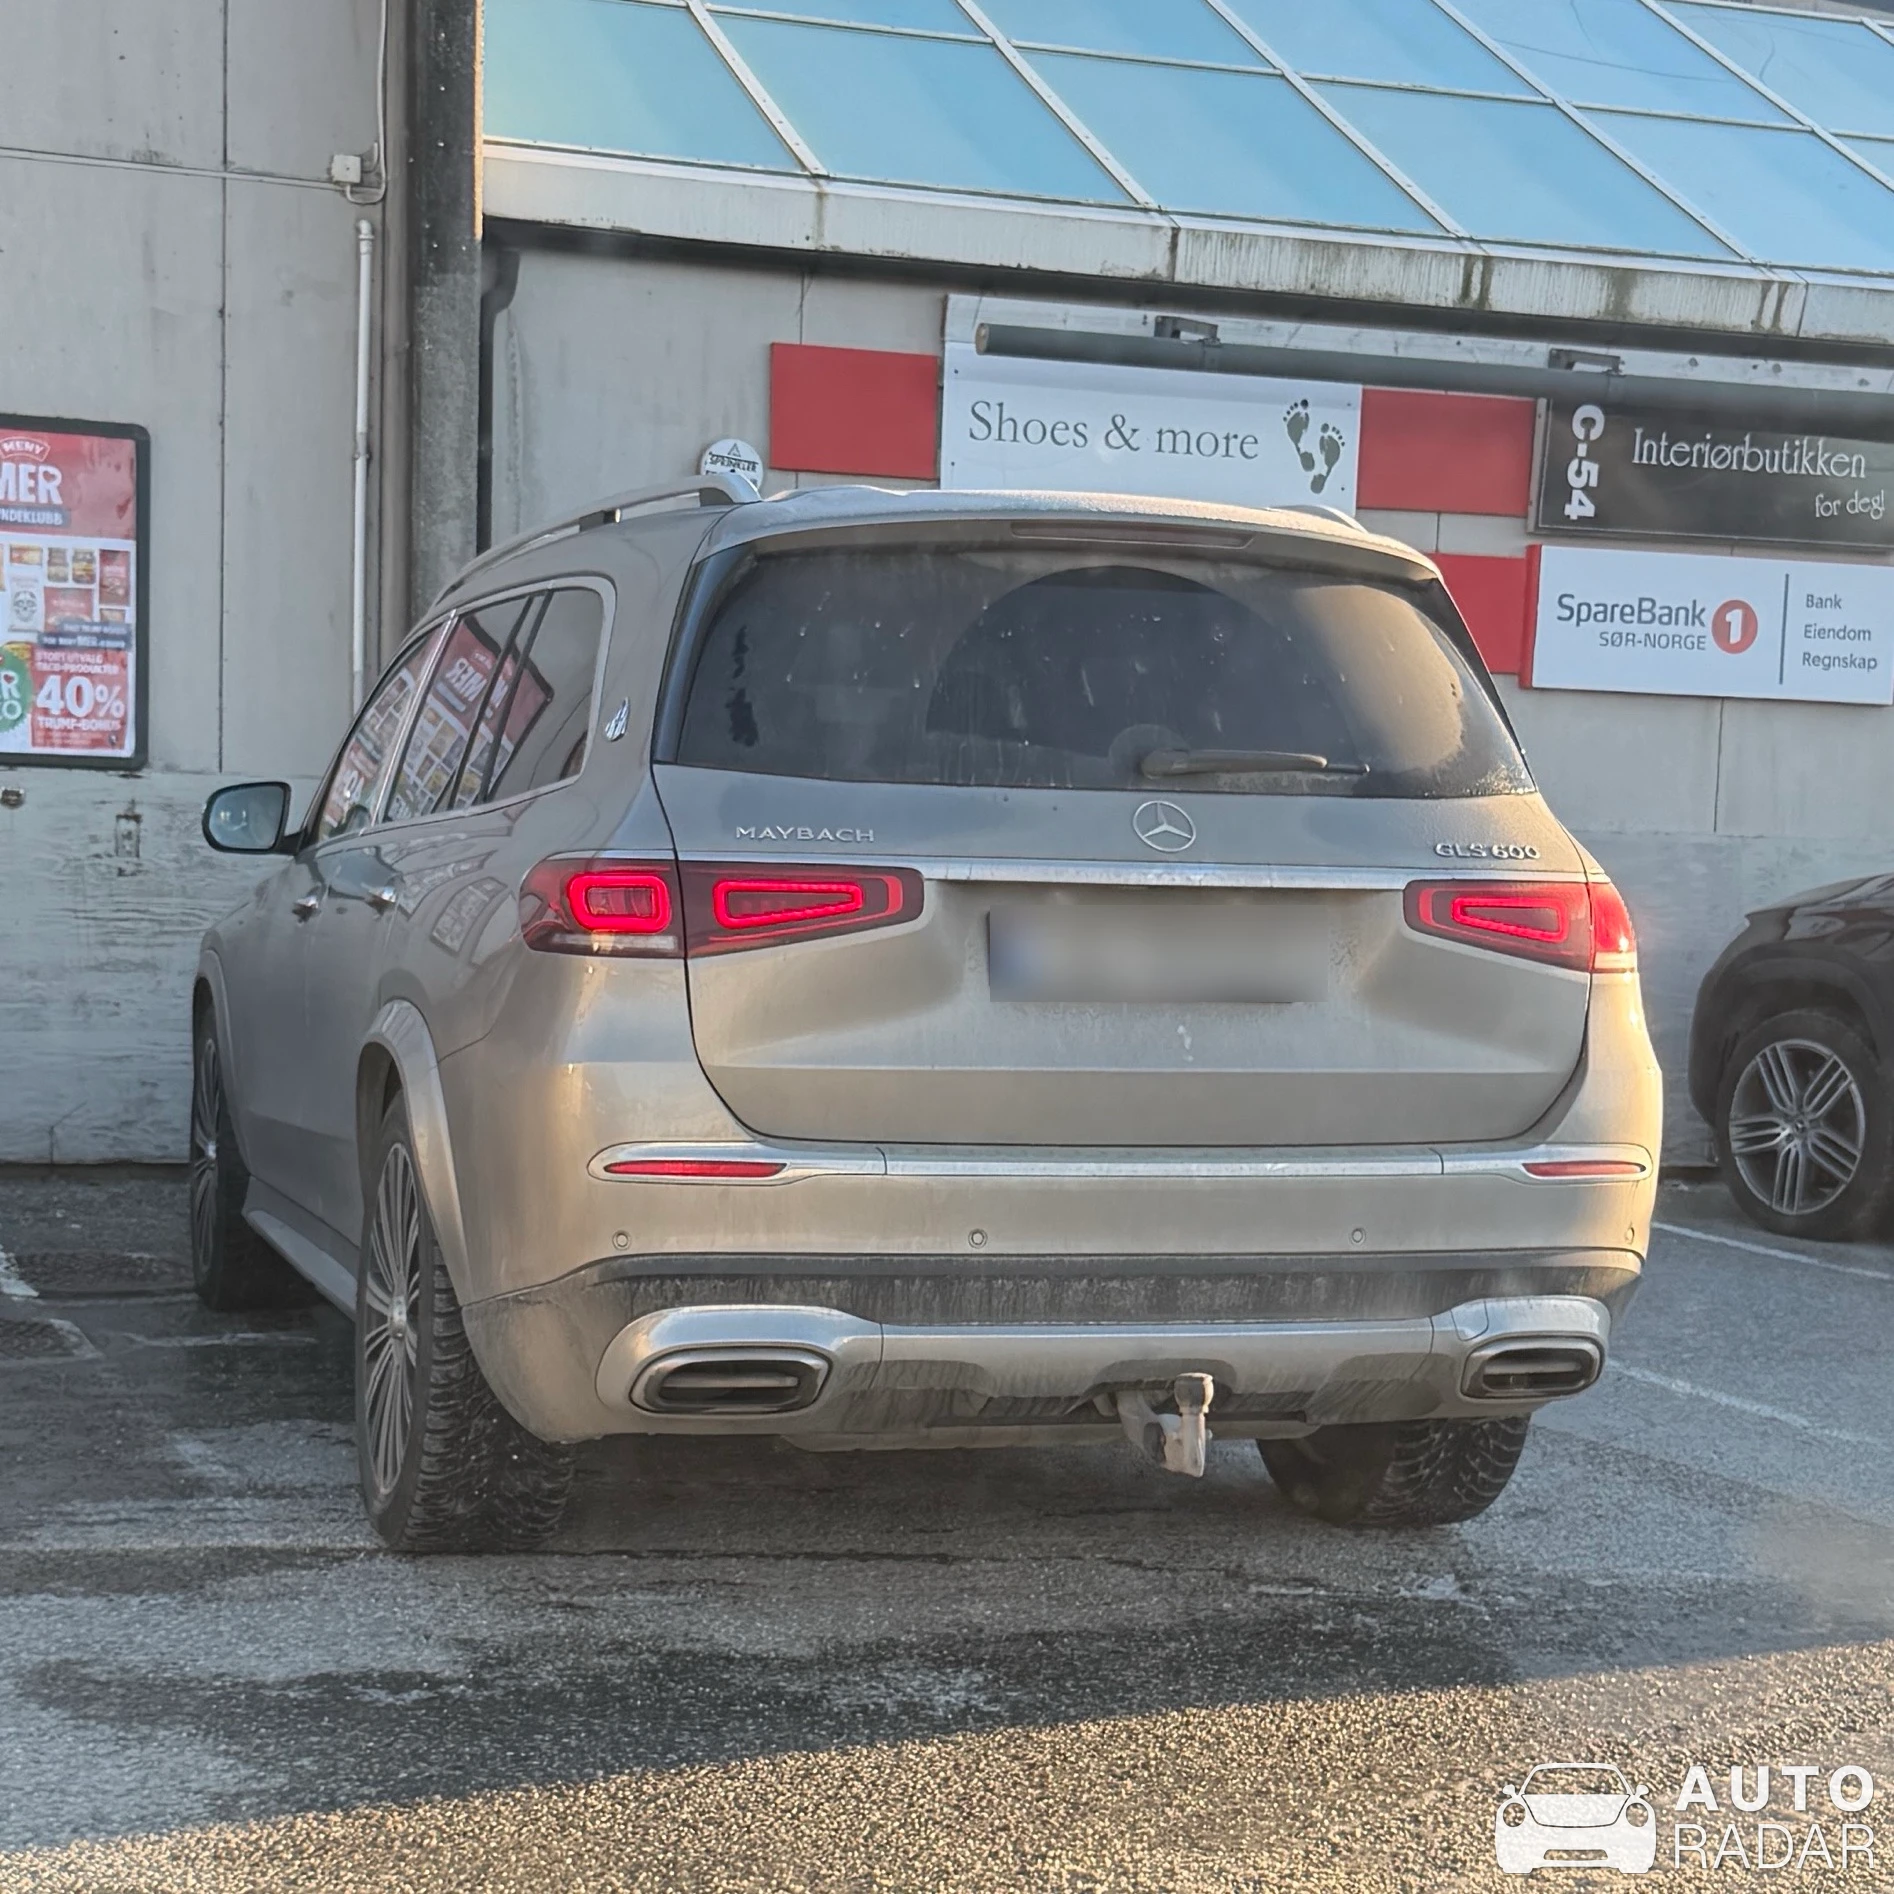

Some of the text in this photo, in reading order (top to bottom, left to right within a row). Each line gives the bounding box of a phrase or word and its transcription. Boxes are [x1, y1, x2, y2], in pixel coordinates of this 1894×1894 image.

[969, 400, 1260, 460] Shoes & more
[1564, 403, 1606, 520] C-54
[1631, 427, 1867, 478] Interiørbutikken
[1815, 493, 1842, 518] for
[0, 508, 63, 526] NDEKLUBB
[1805, 594, 1842, 610] Bank
[1556, 593, 1744, 645] SpareBank 1
[1598, 631, 1707, 651] SØR-NORGE
[1803, 623, 1872, 642] Eiendom
[1802, 651, 1878, 672] Regnskap
[36, 674, 125, 718] 40%
[735, 825, 875, 842] MAYBACH
[1434, 842, 1541, 860] GLS 600
